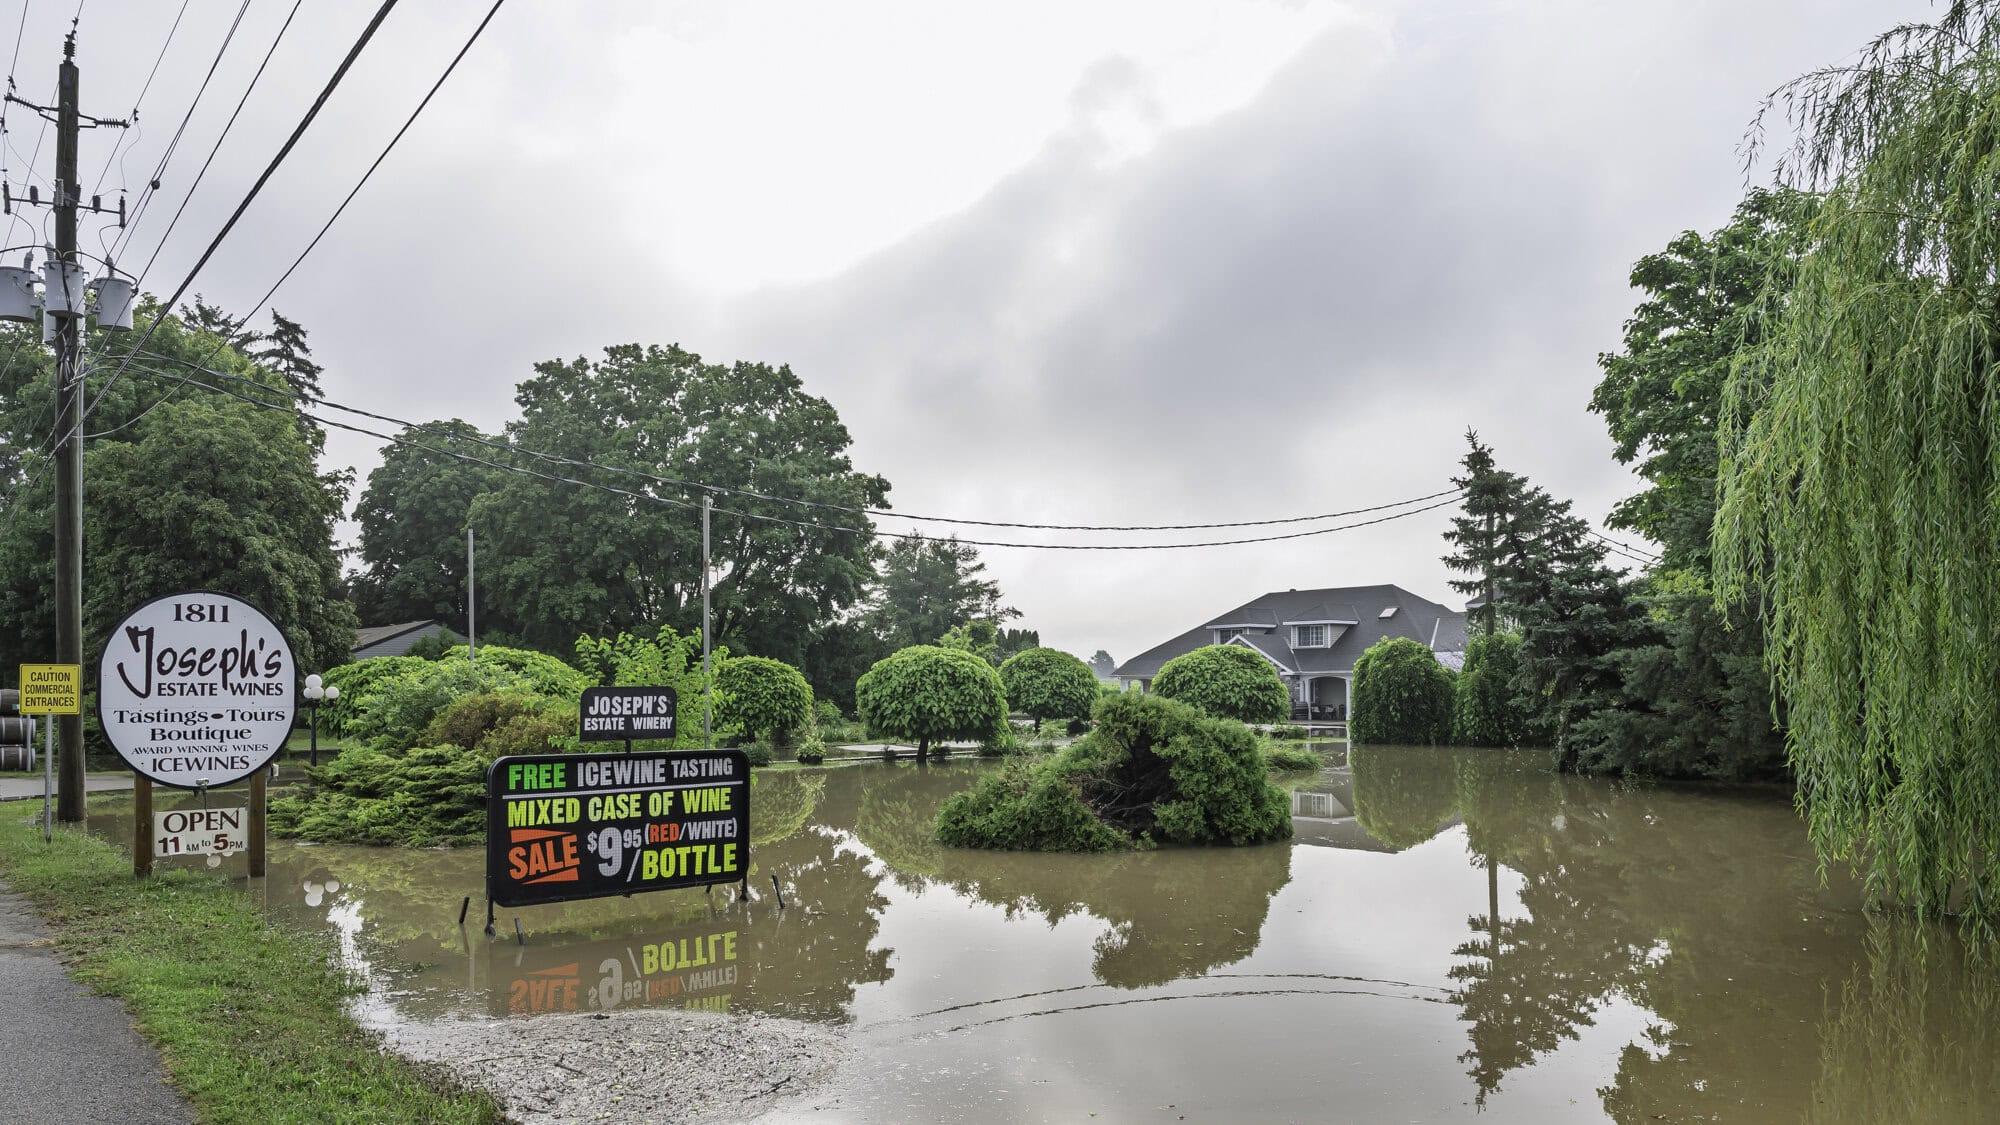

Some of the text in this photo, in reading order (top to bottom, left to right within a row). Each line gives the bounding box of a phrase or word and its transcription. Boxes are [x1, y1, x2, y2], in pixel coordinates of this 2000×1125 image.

[172, 603, 230, 623] 1811
[116, 625, 283, 699] Joseph's
[30, 671, 71, 682] CAUTION
[25, 684, 75, 695] COMMERCIAL
[157, 682, 283, 697] ESTATE WINES
[25, 696, 75, 707] ENTRANCES
[588, 695, 667, 716] JOSEPH'S
[113, 708, 286, 726] Tastings Tours
[584, 716, 673, 731] ESTATE WINERY
[150, 726, 252, 743] Boutique
[131, 743, 269, 755] AWARD WINNING WINES
[151, 755, 250, 773] ICEWINES
[508, 757, 734, 790] FREE ICEWINE TASTING
[507, 787, 732, 828] MIXED CASE OF WINE
[163, 809, 239, 834] OPEN
[158, 836, 180, 854] 11
[186, 843, 200, 852] AM
[202, 839, 211, 848] to
[508, 834, 581, 880] SALE
